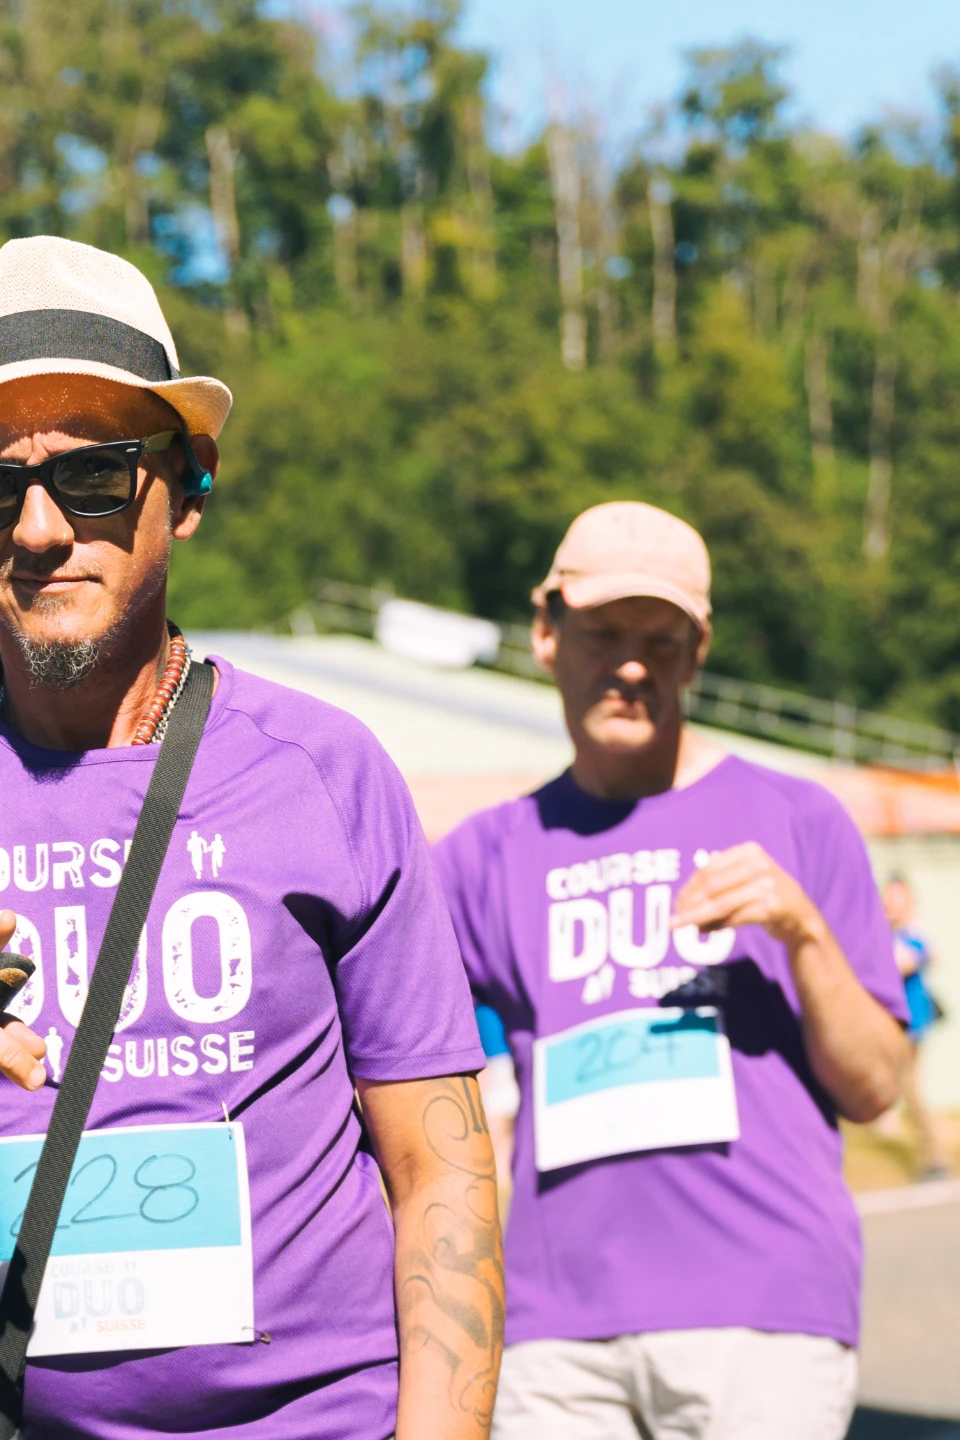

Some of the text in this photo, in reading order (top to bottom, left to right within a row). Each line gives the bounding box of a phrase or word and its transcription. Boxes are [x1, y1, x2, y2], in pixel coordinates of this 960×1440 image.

[100, 1030, 256, 1083] SUISSE
[50, 1260, 115, 1278] COURSE
[52, 1277, 145, 1320] DUO
[96, 1318, 147, 1333] SUISSE
